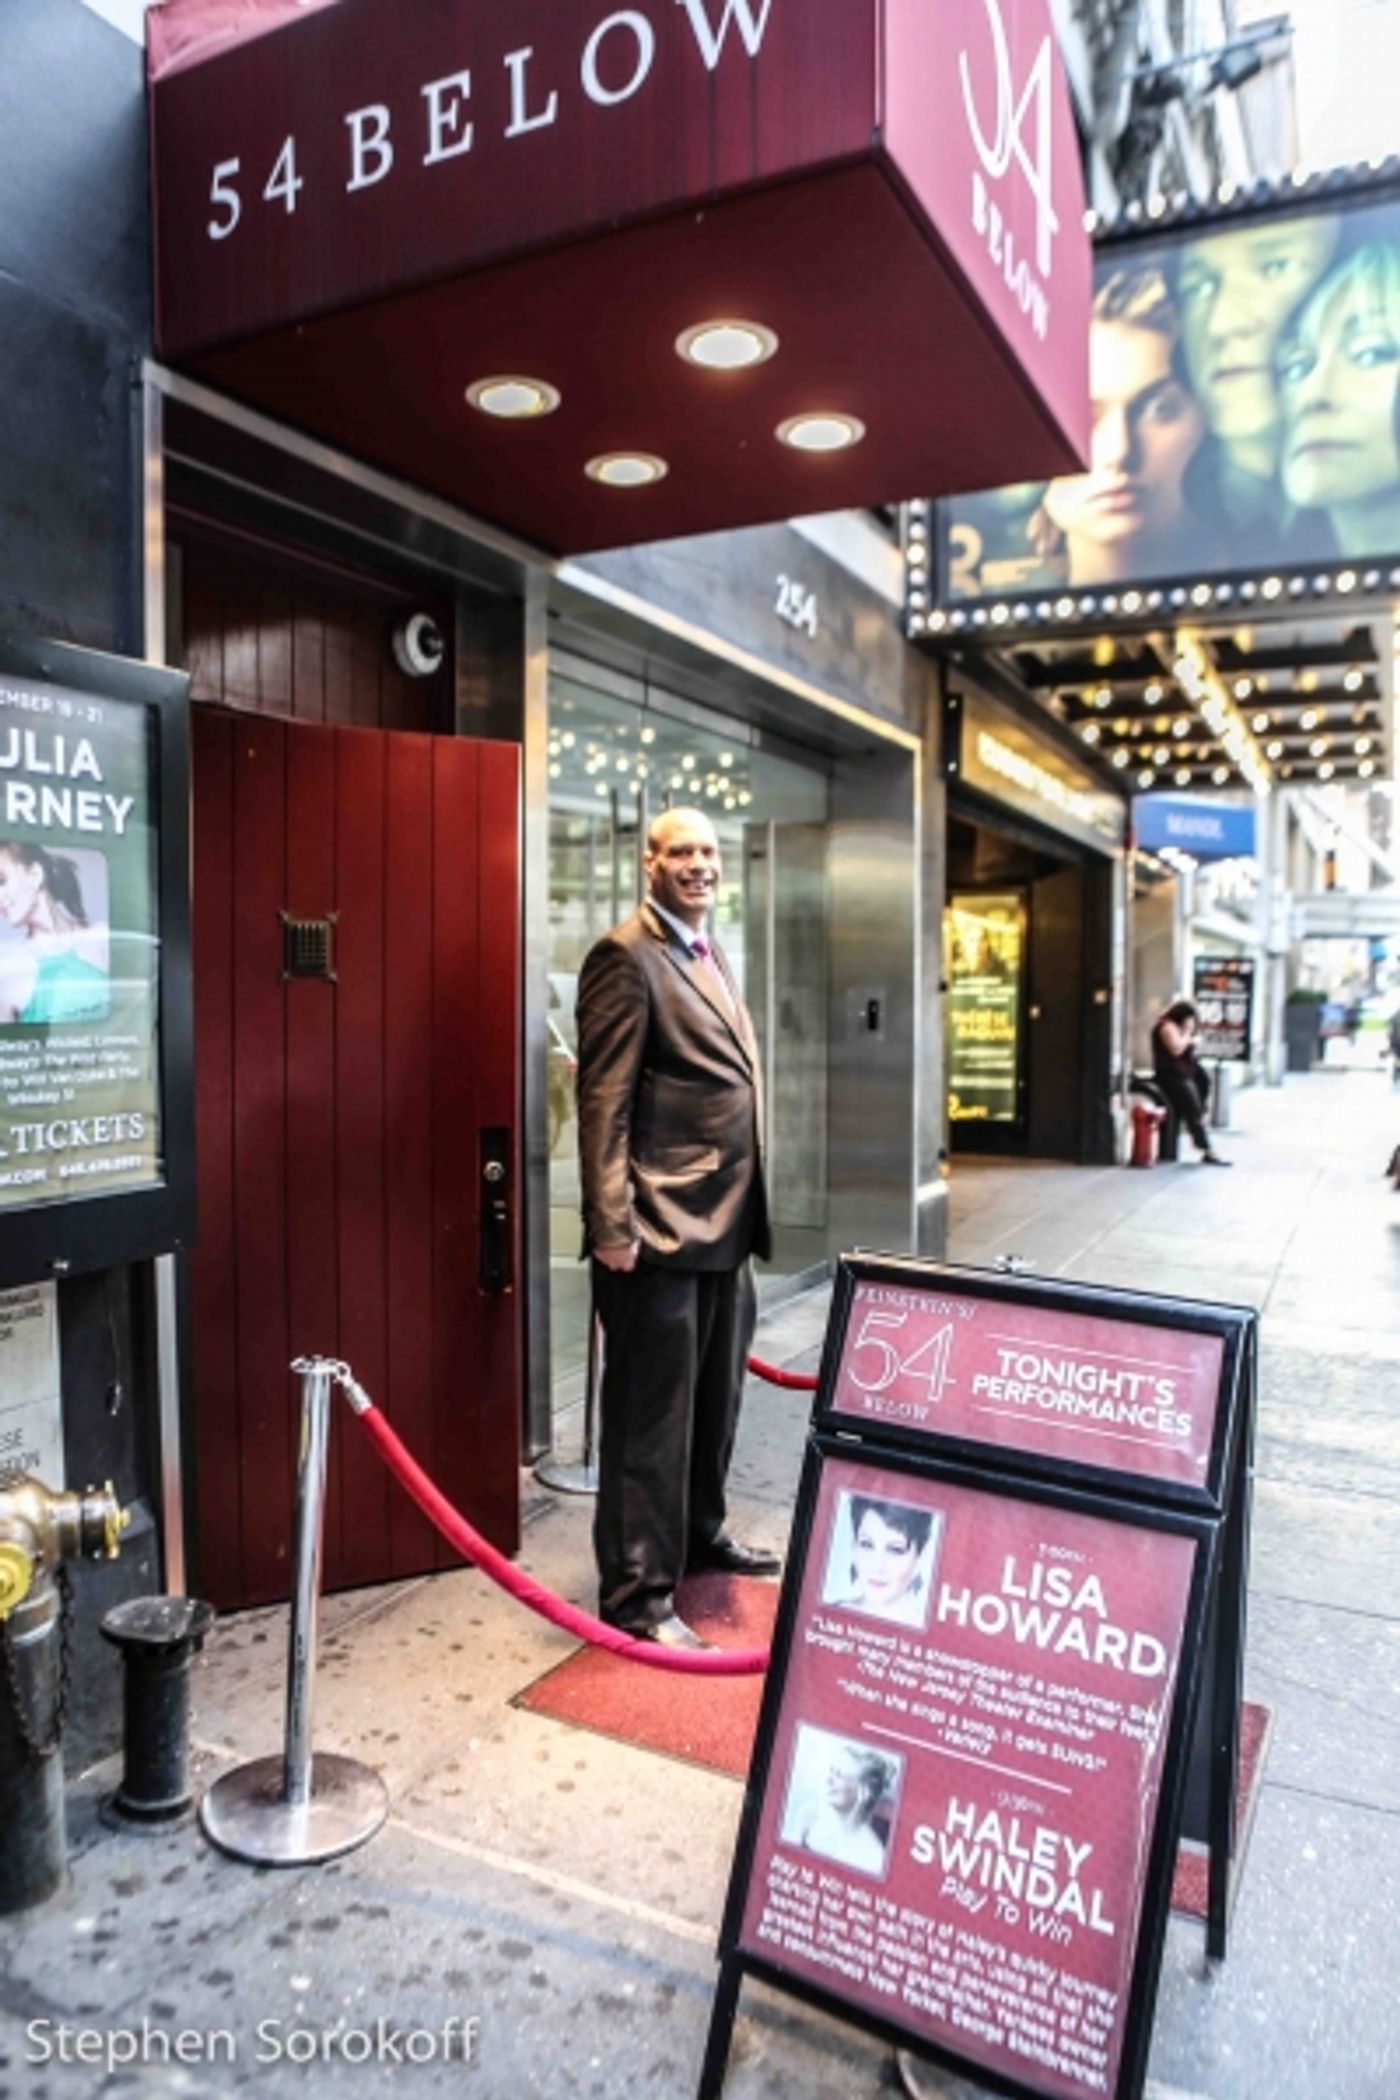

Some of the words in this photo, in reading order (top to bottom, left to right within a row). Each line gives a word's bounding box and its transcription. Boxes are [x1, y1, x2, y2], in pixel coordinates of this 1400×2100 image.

[207, 137, 303, 239] 54
[346, 0, 774, 191] BELOW
[775, 573, 818, 637] 254
[6, 779, 134, 835] RNEY
[10, 1112, 145, 1154] TICKETS
[847, 1311, 958, 1402] 54
[996, 1348, 1176, 1407] TONIGHT'S
[863, 1393, 929, 1421] BELOW
[971, 1373, 1193, 1436] PERFORMANCES
[1001, 1554, 1108, 1619] LISA
[937, 1583, 1167, 1677] HOWARD
[914, 1646, 921, 1657] a
[1036, 1681, 1044, 1692] a
[949, 1715, 957, 1726] a
[946, 1796, 1094, 1878] HALEY
[910, 1824, 1115, 1935] SWINDAL
[940, 1876, 987, 1913] Play
[996, 1894, 1019, 1924] To
[1029, 1908, 1072, 1945] Win
